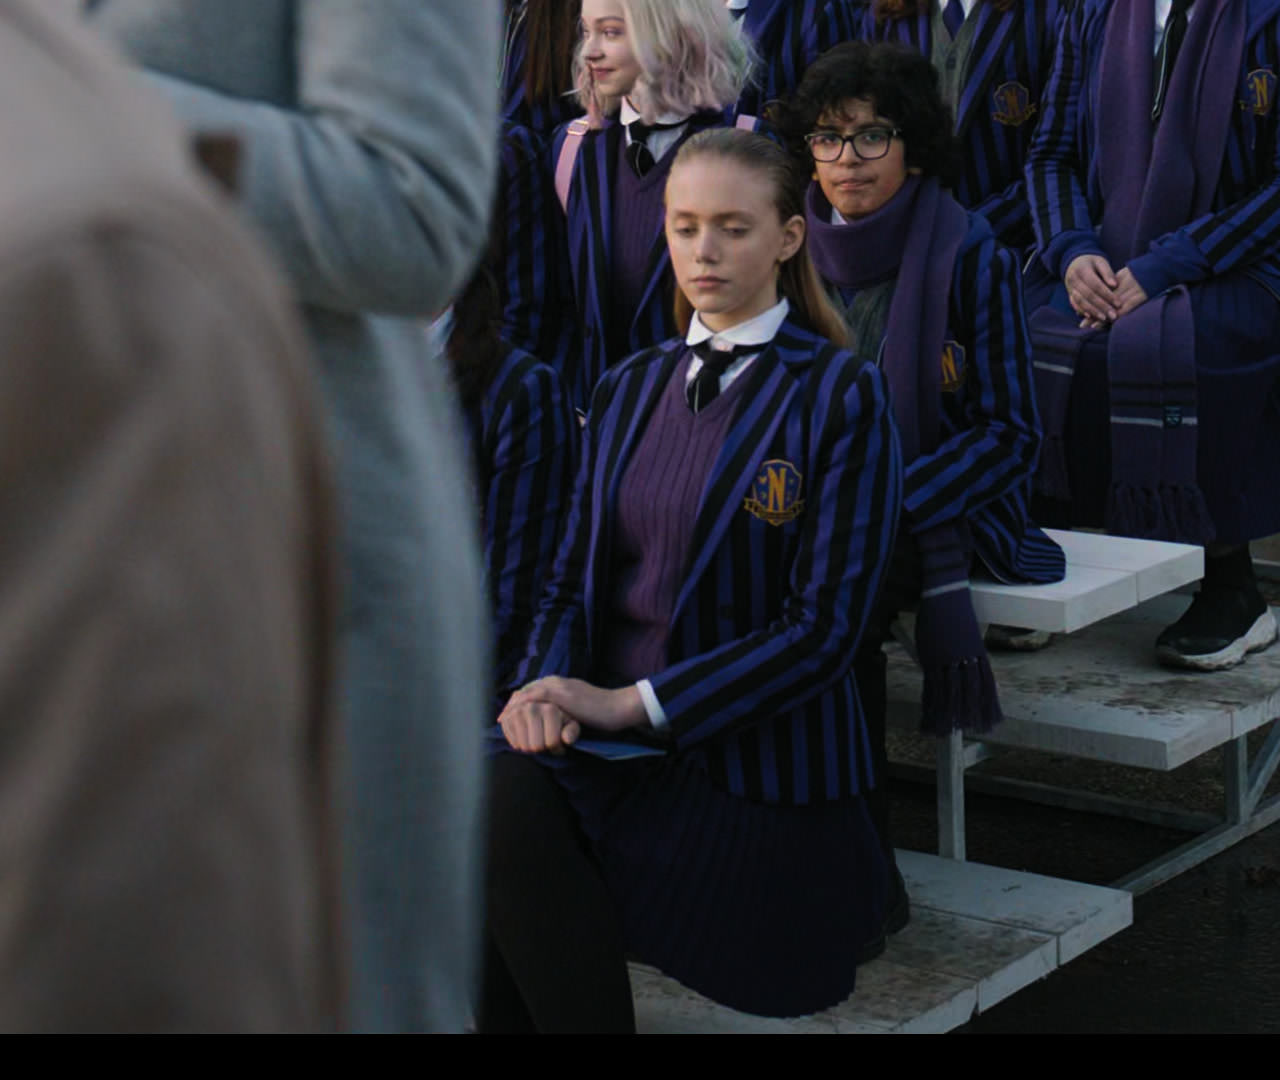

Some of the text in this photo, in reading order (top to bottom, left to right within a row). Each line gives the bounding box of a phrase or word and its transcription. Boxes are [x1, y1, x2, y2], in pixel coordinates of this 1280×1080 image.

[1253, 75, 1268, 108] N
[941, 346, 958, 384] N
[767, 466, 787, 512] N
